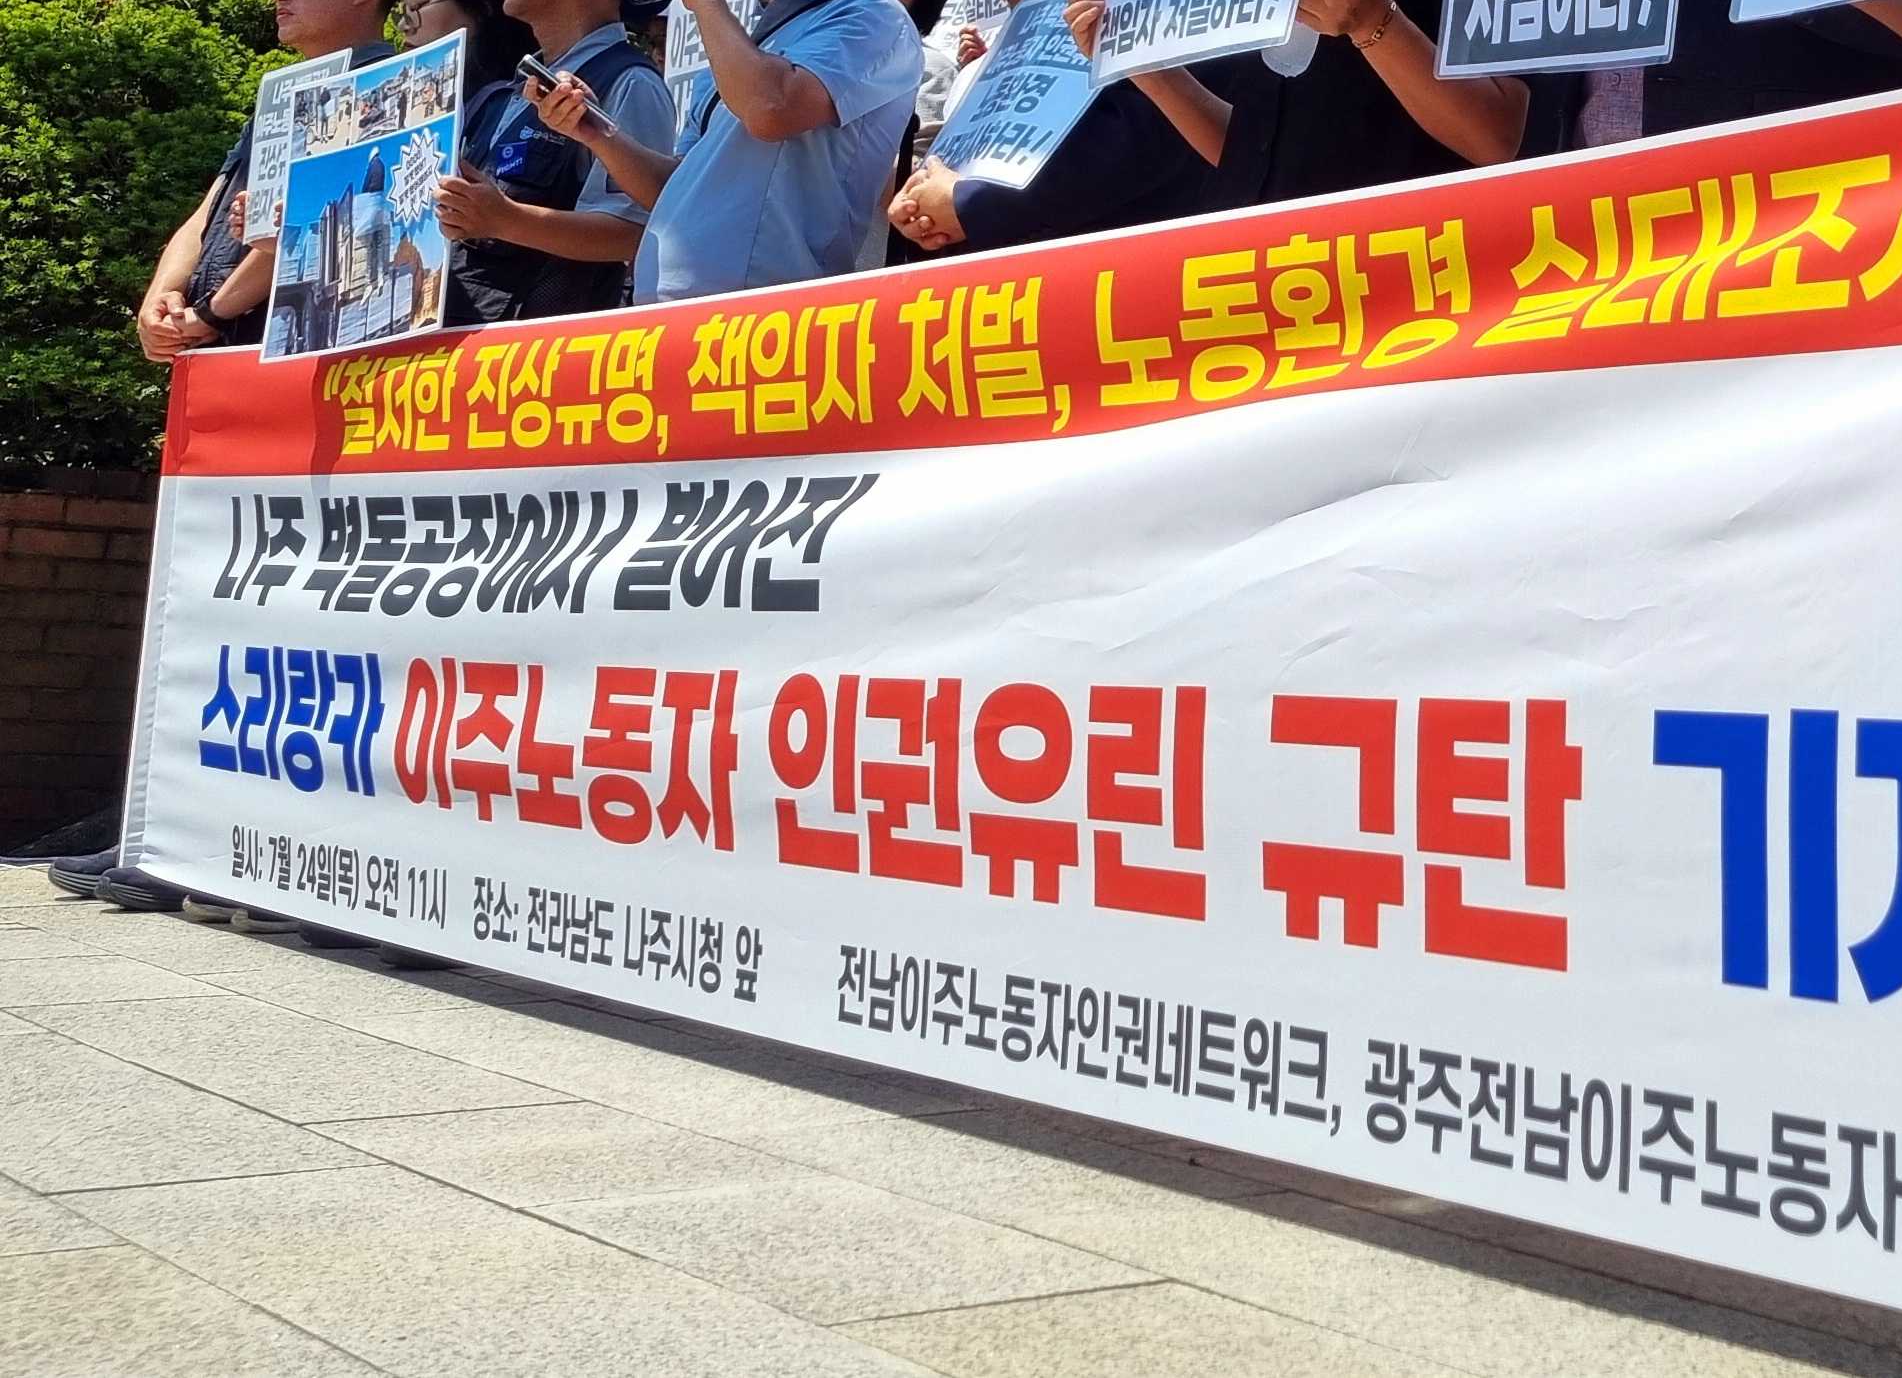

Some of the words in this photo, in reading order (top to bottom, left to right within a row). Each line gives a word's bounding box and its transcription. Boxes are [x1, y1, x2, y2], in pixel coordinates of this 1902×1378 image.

[324, 347, 463, 456] "철저한
[466, 325, 668, 456] 진상규명,
[687, 298, 877, 436] 책임자
[899, 276, 1071, 434] 처벌,
[1095, 218, 1471, 404] 노동환경
[213, 494, 305, 607] 나주
[302, 489, 639, 618] 벽돌공장에서
[613, 473, 881, 613] 벌어진
[200, 644, 385, 797] 스리랑카
[394, 657, 739, 852] 이주노동자
[767, 672, 1207, 922] 인권유린
[1261, 694, 1583, 972] 규탄
[231, 824, 263, 882] 일시:
[267, 836, 292, 890] 7월
[296, 842, 359, 912] 24일(목)
[364, 855, 399, 918] 오전
[407, 868, 448, 929] 11시
[472, 876, 519, 943] 장소:
[526, 885, 616, 966] 전라남도
[623, 905, 723, 994] 나주시청
[734, 924, 763, 1003] 앞
[837, 943, 1342, 1138] 전남이주노동자인권네트워크,
